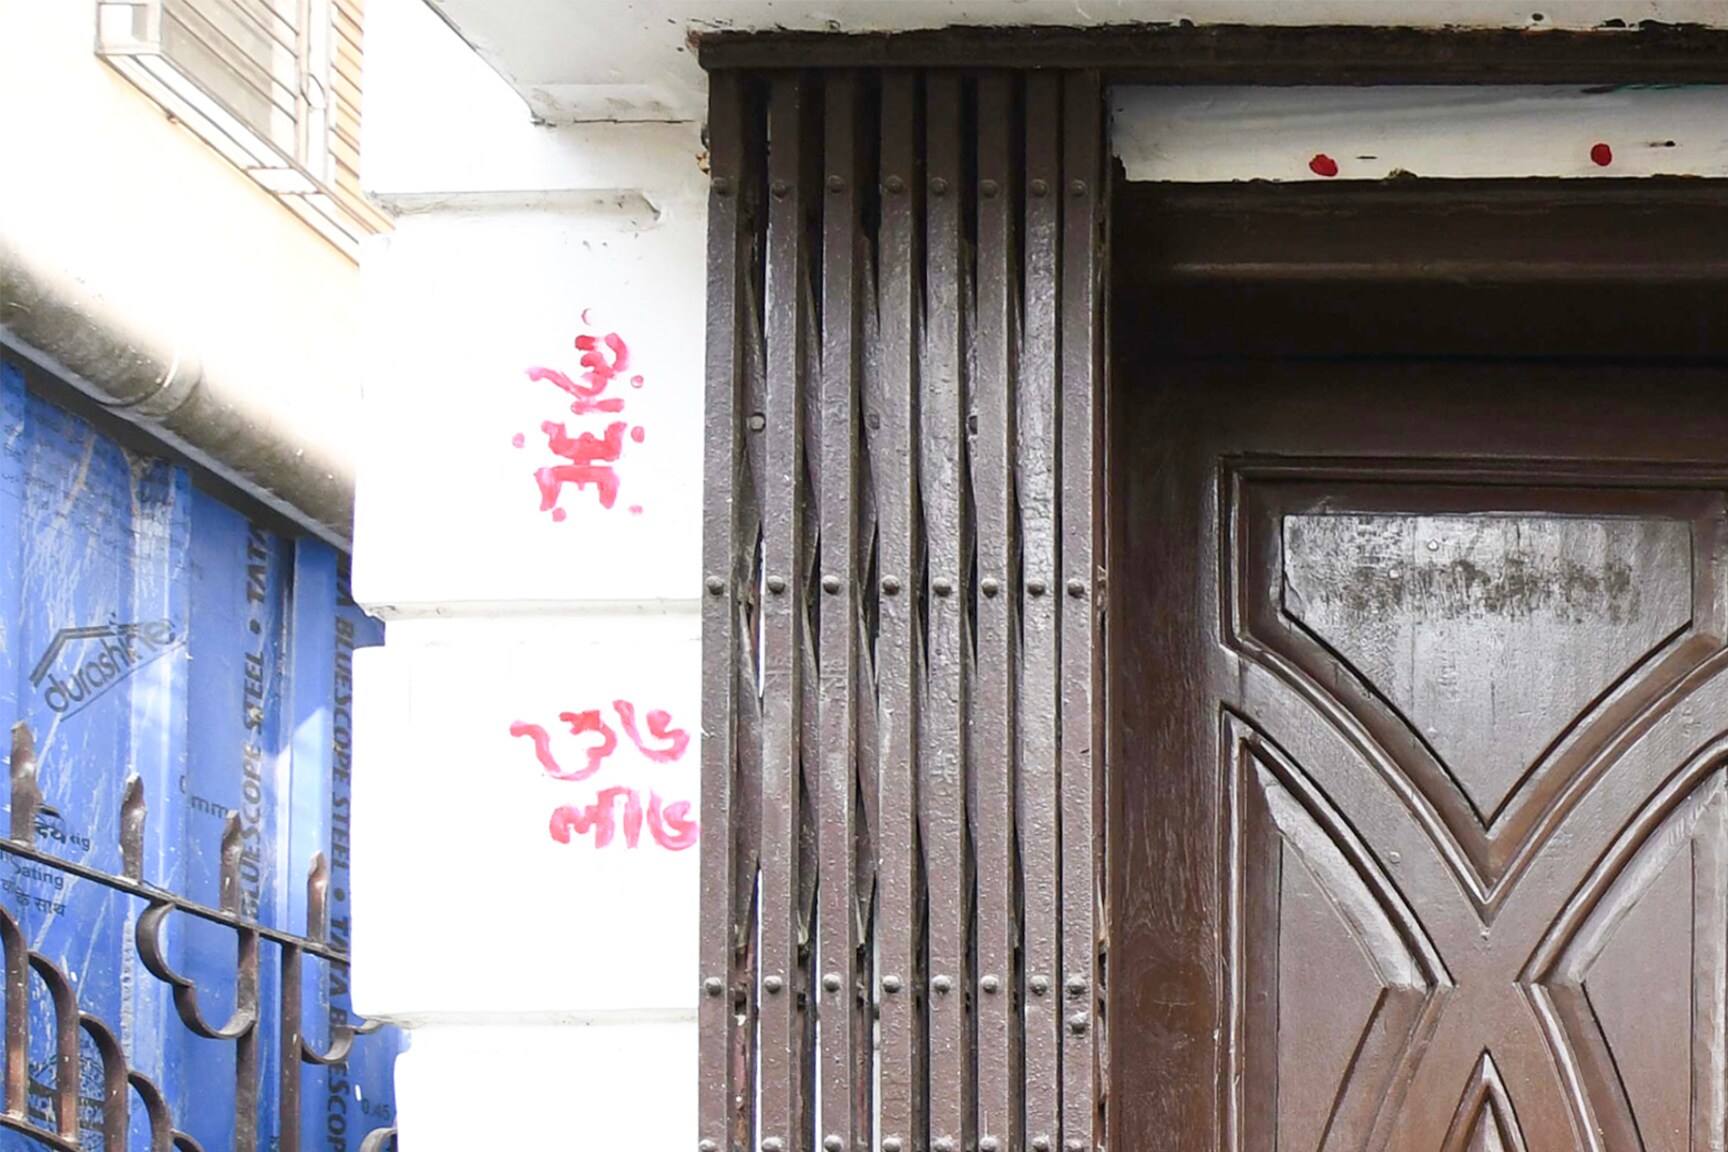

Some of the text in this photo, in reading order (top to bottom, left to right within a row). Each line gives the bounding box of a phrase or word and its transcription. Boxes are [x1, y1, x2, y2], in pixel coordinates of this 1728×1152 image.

[242, 651, 265, 735] STEEL
[333, 615, 354, 787] BLUESCOPE
[332, 791, 352, 875] STEEL
